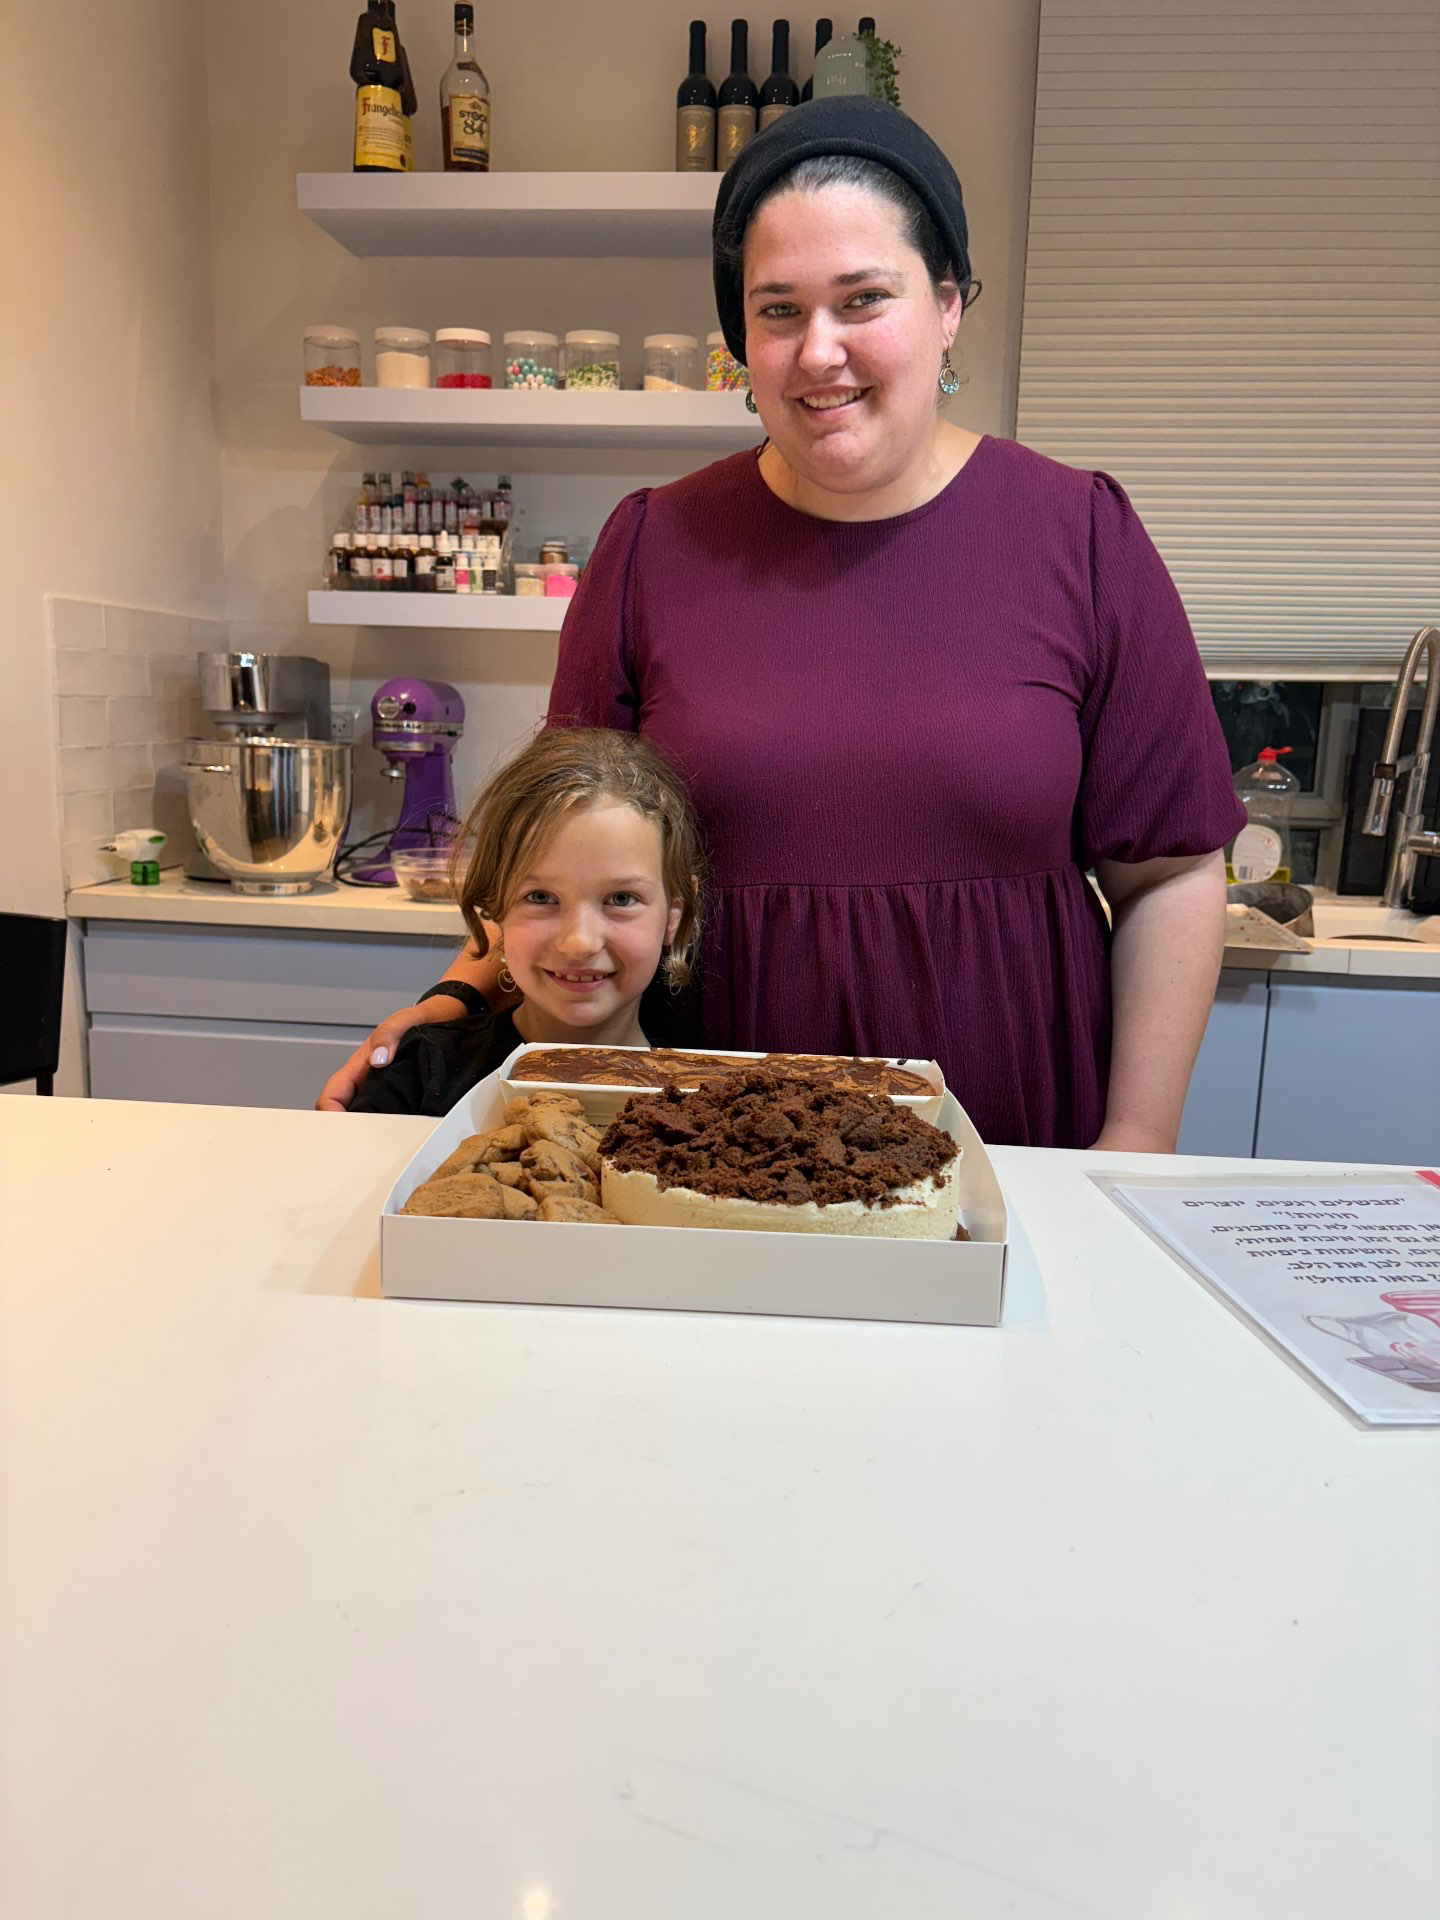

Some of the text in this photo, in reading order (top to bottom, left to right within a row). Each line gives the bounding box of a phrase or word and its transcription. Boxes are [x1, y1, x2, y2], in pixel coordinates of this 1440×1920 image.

[361, 97, 403, 117] Frangelic
[459, 110, 488, 122] STOC
[463, 119, 485, 137] 84
[1181, 1200, 1245, 1208] יוצרים
[1255, 1200, 1317, 1208] רגעים,
[1210, 1224, 1292, 1234] מתכונים,
[1293, 1223, 1321, 1232] רק
[1322, 1222, 1348, 1230] לא
[1234, 1236, 1296, 1246] אמיתי,
[1357, 1235, 1392, 1244] זמן
[1246, 1249, 1312, 1258] כיפיות
[1313, 1247, 1401, 1255] ומשימות
[1286, 1261, 1331, 1270] הלב.
[1332, 1261, 1367, 1269] את
[1367, 1259, 1402, 1269] לכן
[1378, 1275, 1429, 1283] בואו
